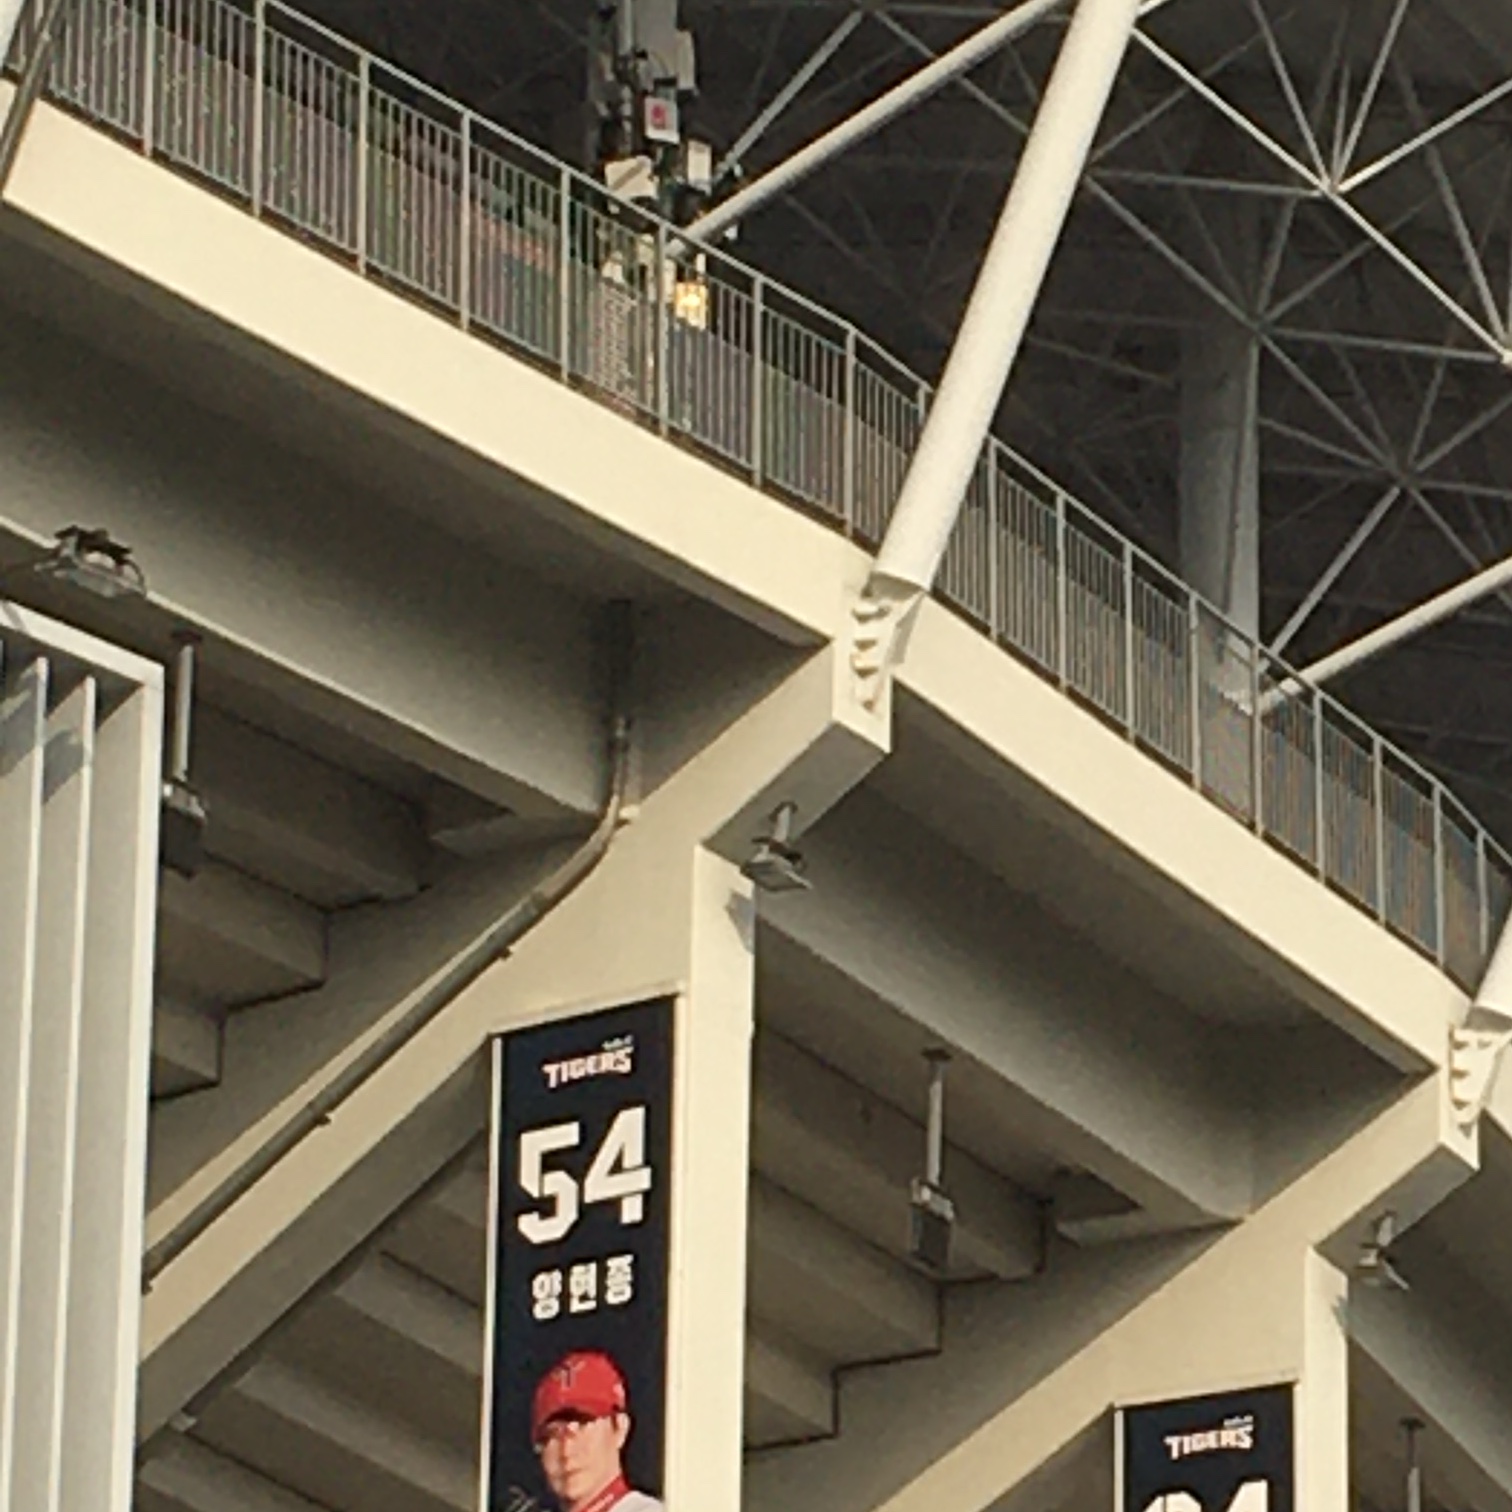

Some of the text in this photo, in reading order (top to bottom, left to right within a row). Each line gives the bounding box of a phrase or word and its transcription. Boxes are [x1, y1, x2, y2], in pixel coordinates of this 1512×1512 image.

[542, 1047, 634, 1089] TIGERS
[517, 1105, 652, 1244] 54
[532, 1254, 635, 1321] 양현종
[1164, 1424, 1254, 1460] TIGERS
